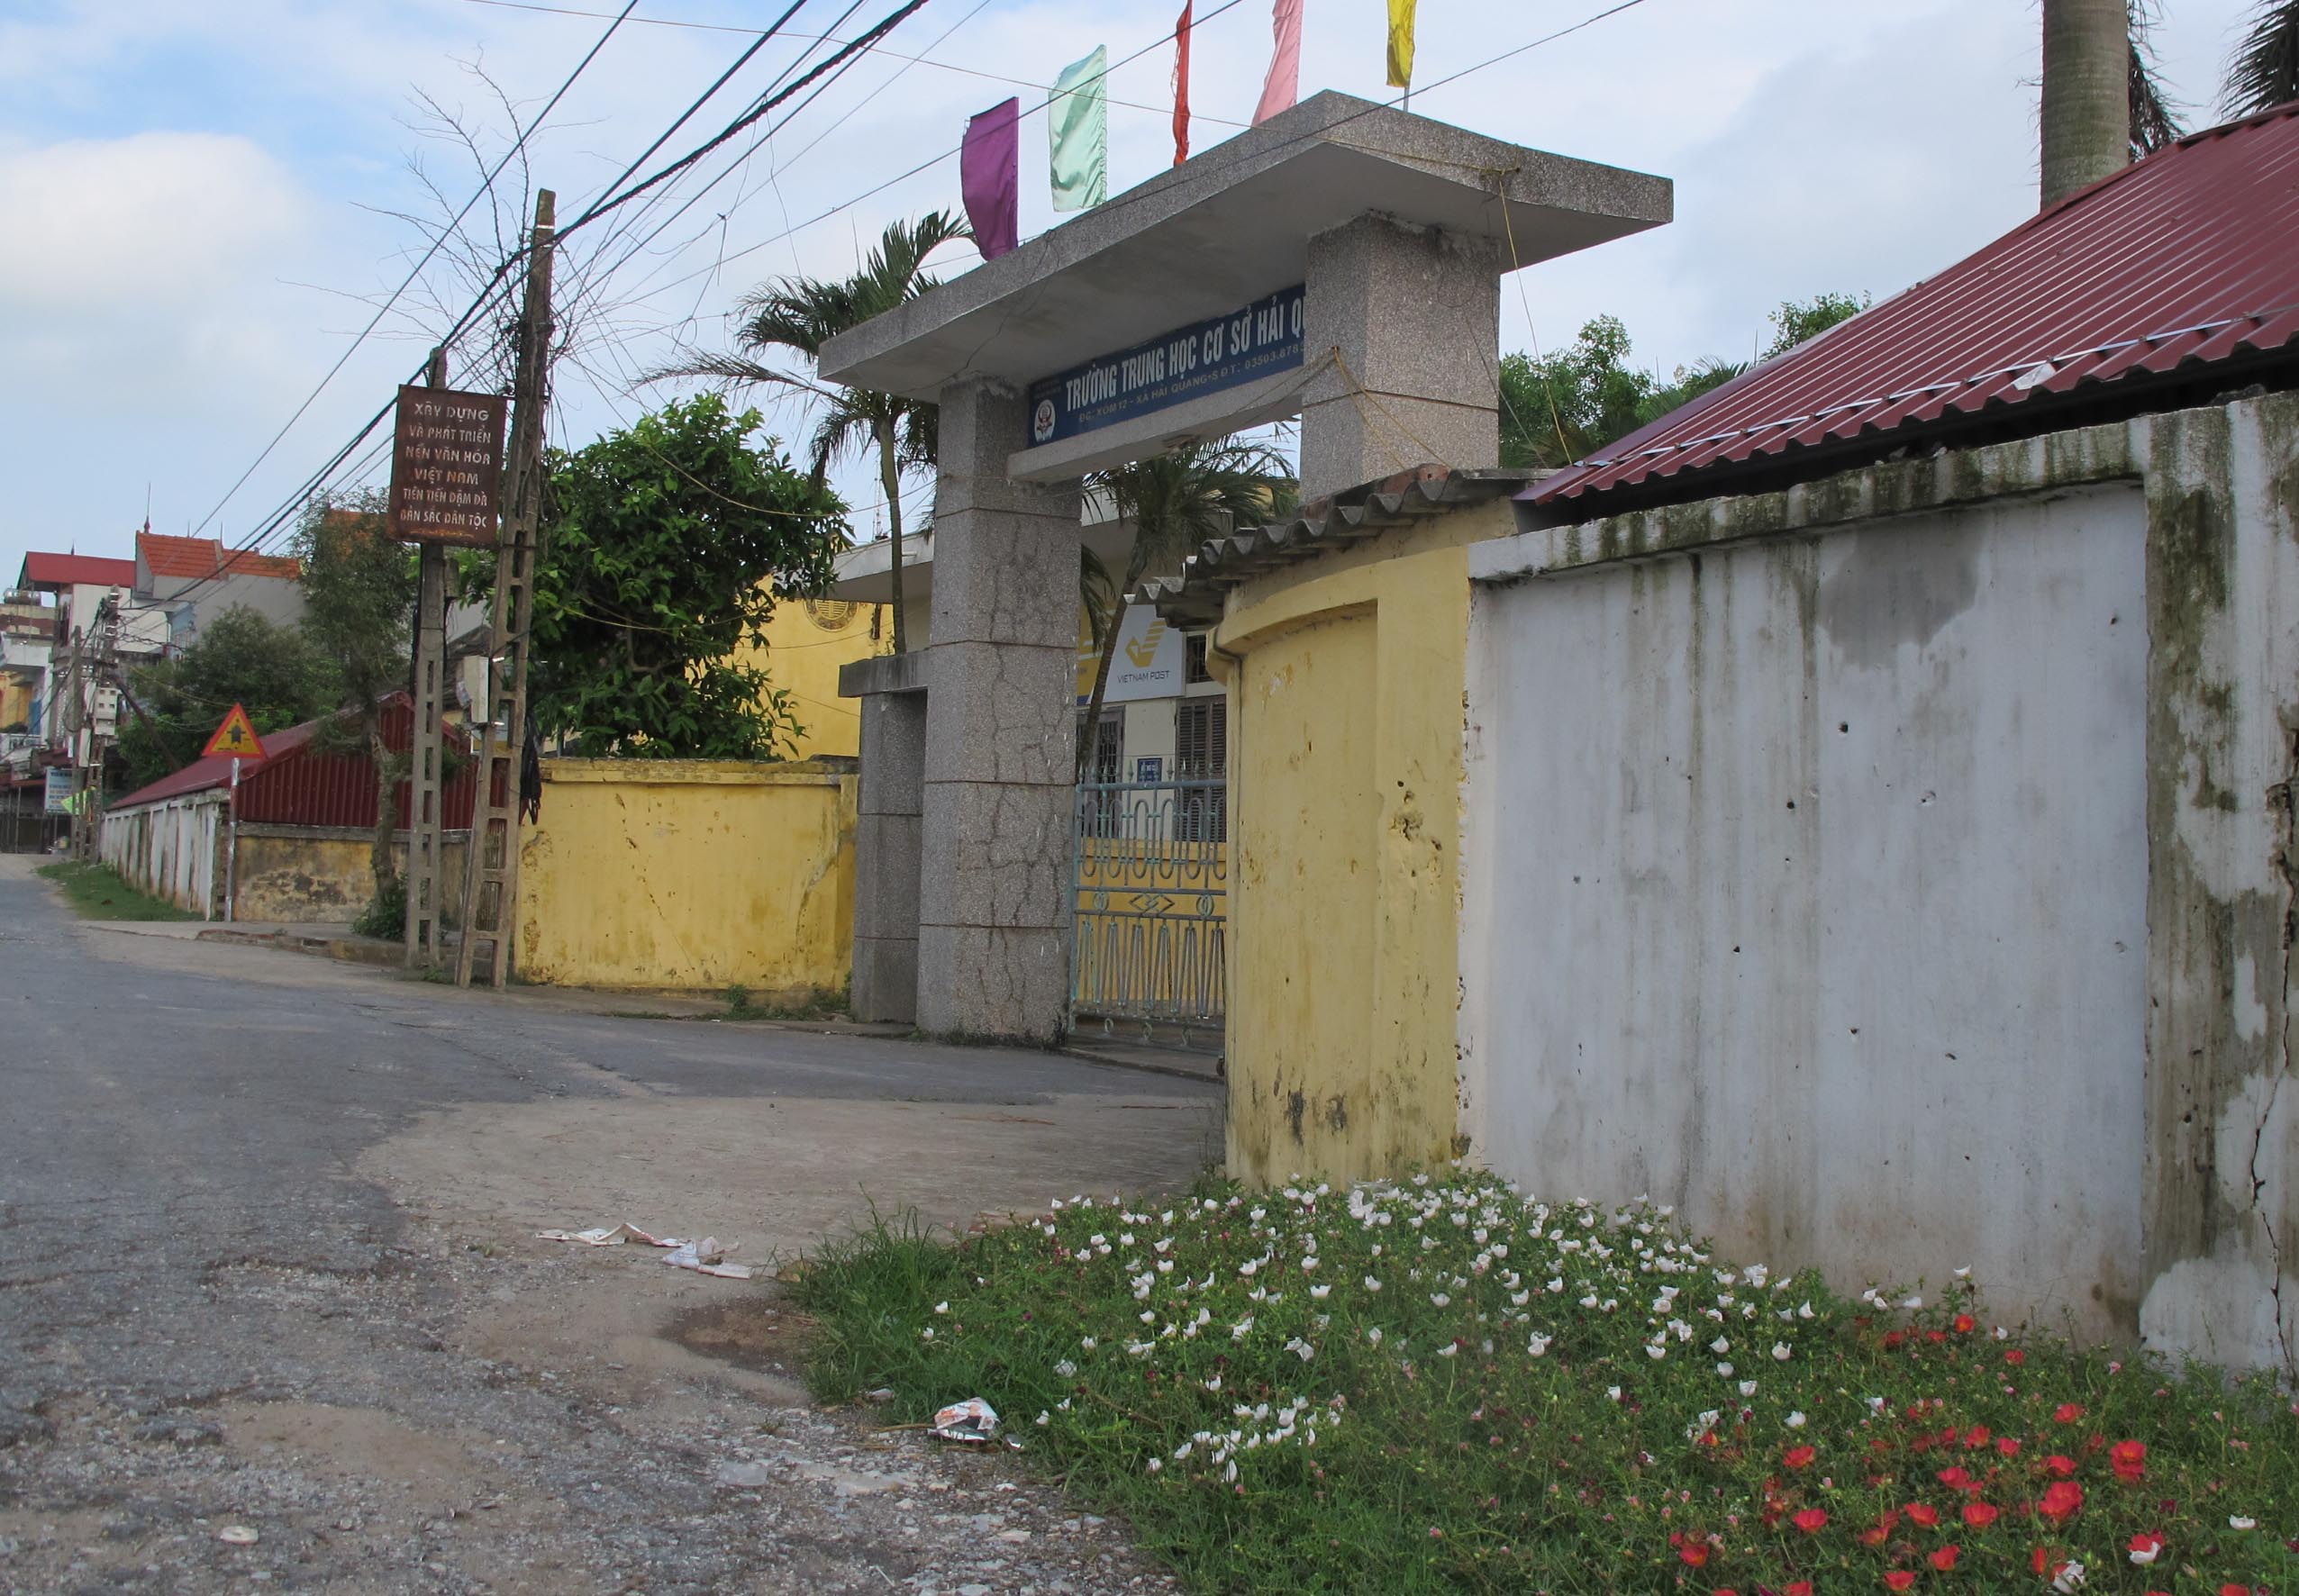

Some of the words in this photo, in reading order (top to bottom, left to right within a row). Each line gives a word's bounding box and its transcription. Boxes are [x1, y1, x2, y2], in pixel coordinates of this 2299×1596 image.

[1066, 362, 1118, 412] TRƯỜNG
[1122, 346, 1164, 393] TRUNG
[1168, 335, 1197, 380] HỌC
[1203, 322, 1225, 365] CƠ
[1230, 304, 1253, 356] SỞ
[1257, 295, 1284, 346] HẢI
[1171, 373, 1208, 394] QUANG
[413, 401, 441, 417] XÂY
[409, 422, 423, 438] VÀ
[427, 425, 457, 440] PHÁT
[459, 424, 491, 443] TRIỂN
[434, 446, 459, 462] VĂN
[463, 449, 491, 465] HÓA
[413, 467, 443, 485] VIỆT
[446, 469, 479, 485] NAM
[403, 486, 423, 501] TIÊN
[426, 487, 447, 503] TIẾN
[473, 491, 487, 507] ĐÀ
[399, 504, 421, 521] BẢN
[423, 505, 441, 523] SẮC
[443, 510, 465, 526] DÂN
[468, 512, 487, 530] TỘC
[1117, 672, 1150, 684] VIETNAM
[1150, 670, 1170, 681] POST
